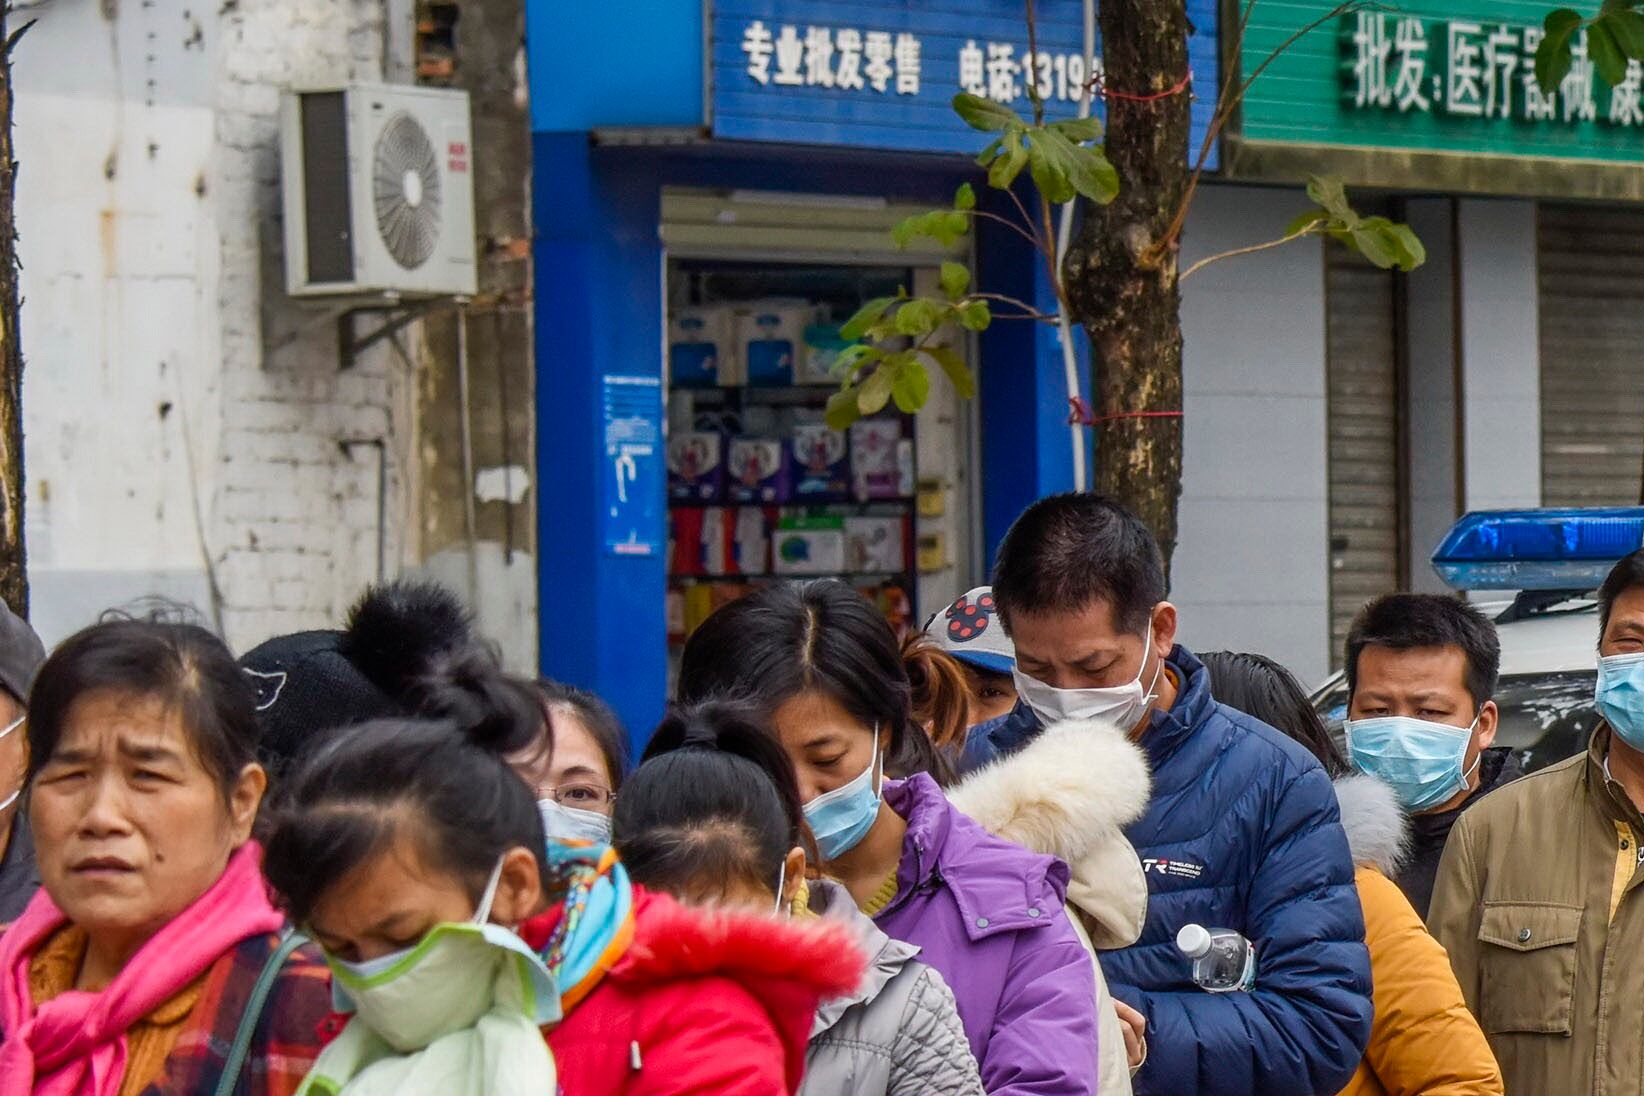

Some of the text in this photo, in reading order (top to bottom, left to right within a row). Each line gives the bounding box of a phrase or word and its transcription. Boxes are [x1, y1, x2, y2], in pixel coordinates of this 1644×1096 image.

[741, 20, 921, 96] 专业批发零售
